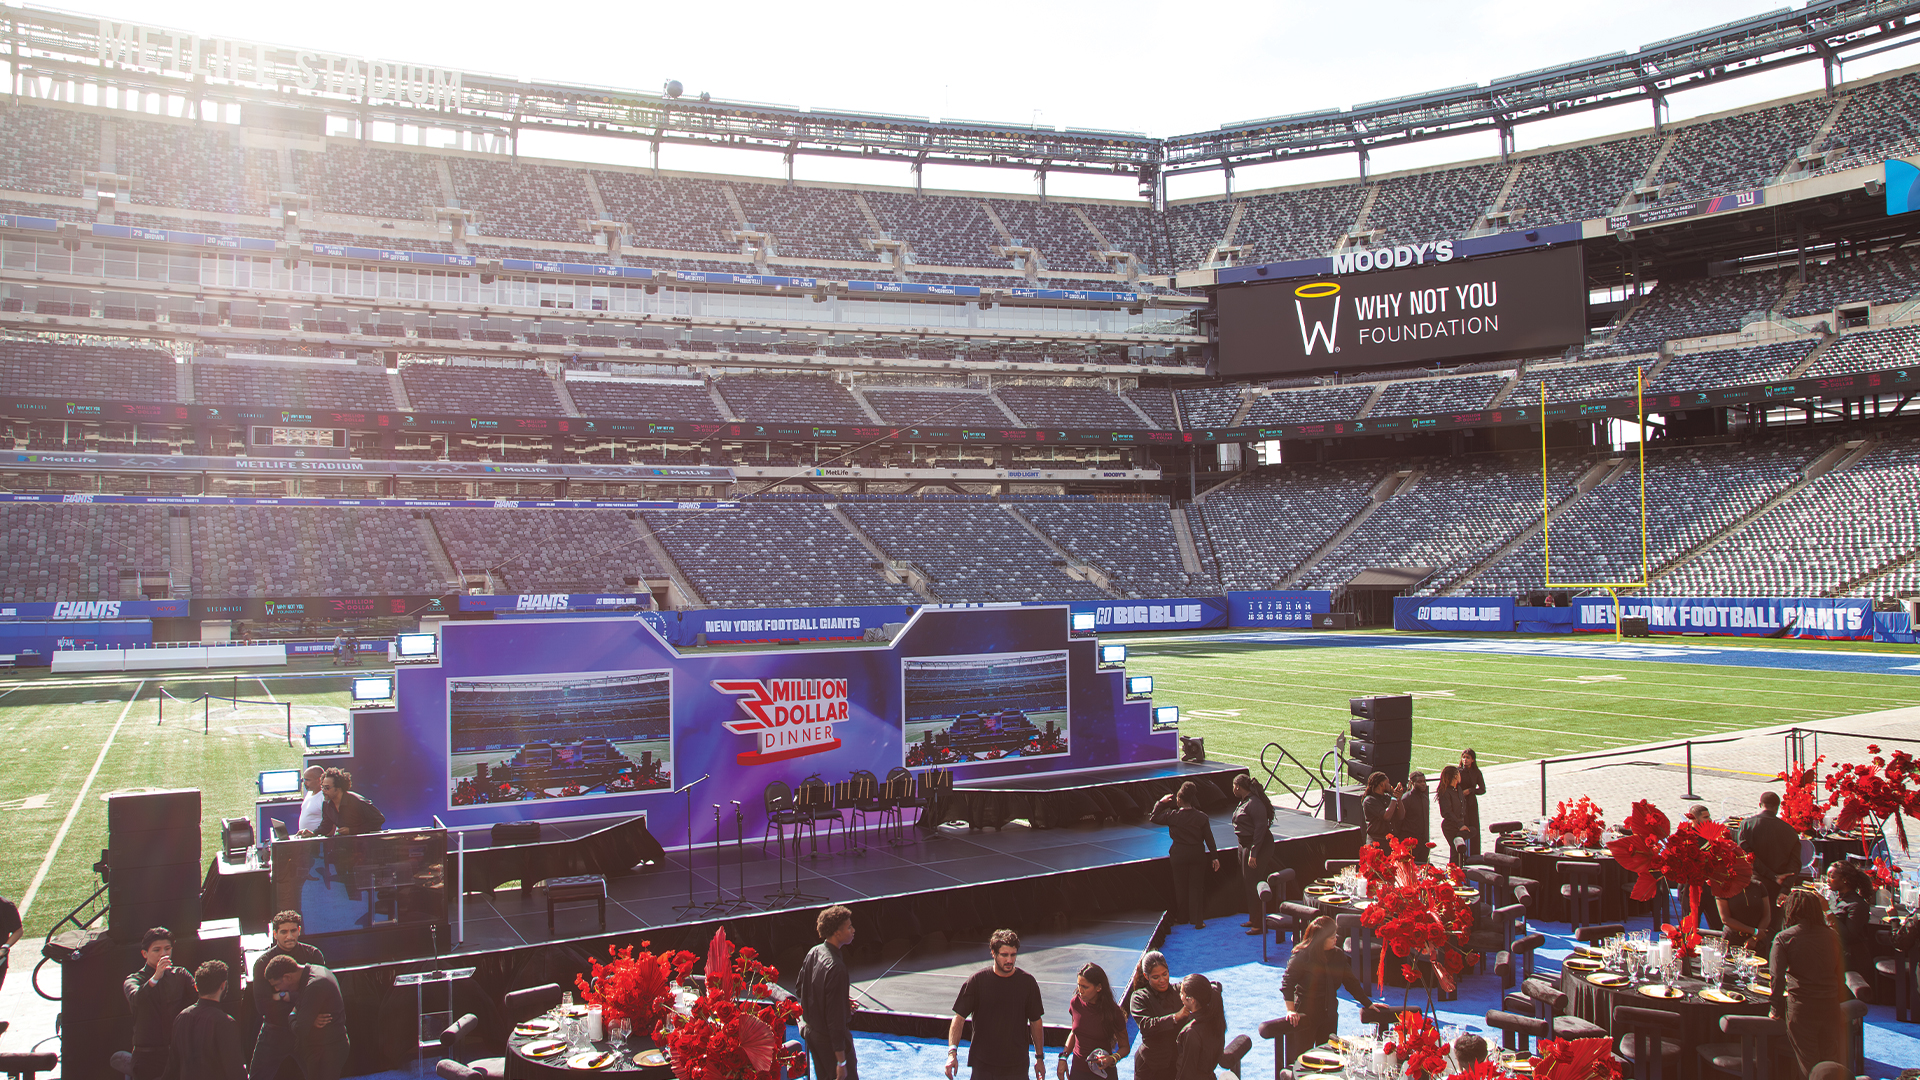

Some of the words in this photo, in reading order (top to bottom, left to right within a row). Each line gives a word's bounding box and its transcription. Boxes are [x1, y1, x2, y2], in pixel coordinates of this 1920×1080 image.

[99, 19, 278, 85] METLIFE
[294, 52, 464, 109] STADIUM
[1611, 221, 1631, 229] Help?
[1331, 241, 1455, 277] MOODY'S
[1354, 293, 1402, 321] WHY
[1409, 287, 1450, 316] NOT
[1455, 282, 1498, 310] YOU
[1358, 314, 1500, 345] FOUNDATION
[42, 456, 97, 464] MetLife
[236, 460, 297, 469] METLIFE
[301, 461, 363, 470] STADIUM
[62, 495, 94, 503] GIANTS
[53, 601, 122, 620] GIANTS
[516, 594, 569, 611] GIANTS
[1096, 607, 1112, 625] GO
[1113, 605, 1148, 625] BIG
[1149, 604, 1202, 624] BLUE
[1417, 606, 1430, 621] GO
[1430, 606, 1458, 621] BIG
[1458, 606, 1501, 621] BLUE
[1580, 605, 1626, 624] NEW
[1679, 606, 1781, 628] FOOTBALL
[1782, 606, 1863, 631] GIANTS
[705, 621, 732, 633] NEW
[733, 619, 763, 632] YORK
[764, 619, 818, 632] FOOTBALL
[819, 617, 861, 630] GIANTS
[772, 678, 848, 703] MILLION
[774, 701, 849, 727] DOLLAR
[764, 726, 833, 749] DINNER
